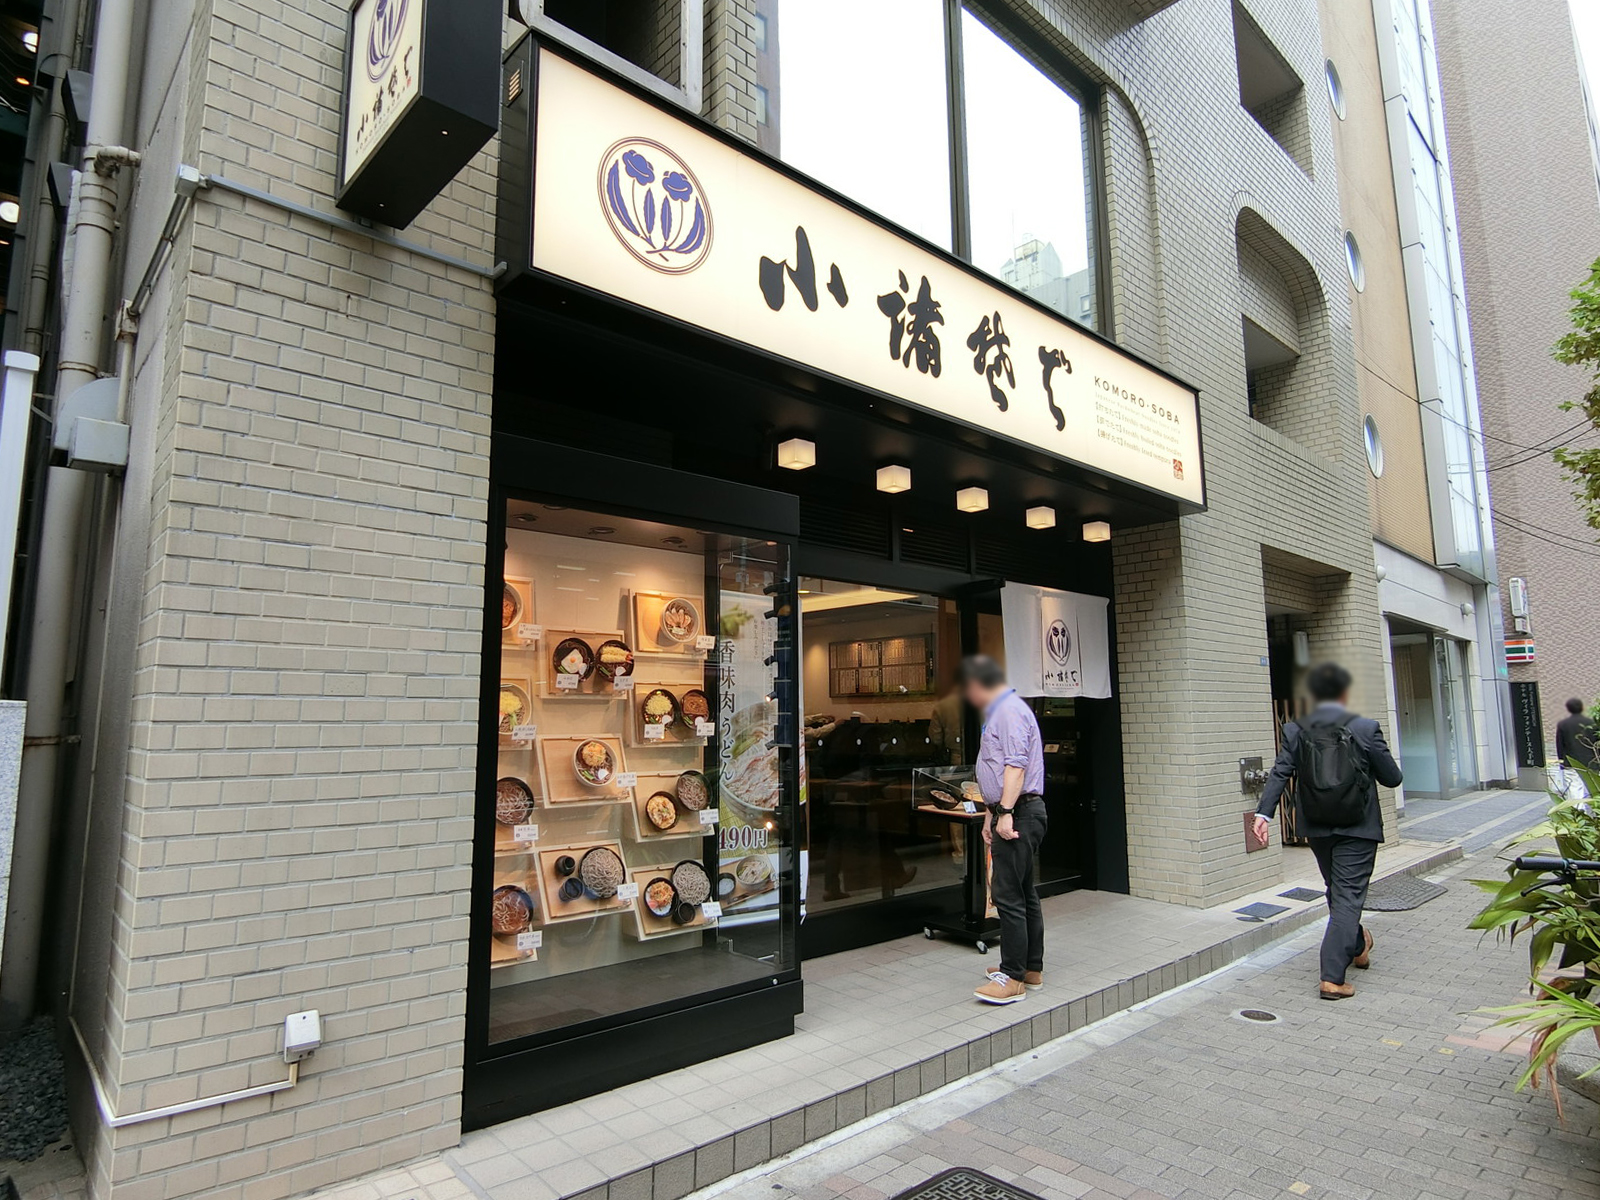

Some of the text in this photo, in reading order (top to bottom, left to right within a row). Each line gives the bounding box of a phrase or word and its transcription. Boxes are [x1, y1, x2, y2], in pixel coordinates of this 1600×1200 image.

[720, 641, 735, 781] 香味肉うどん
